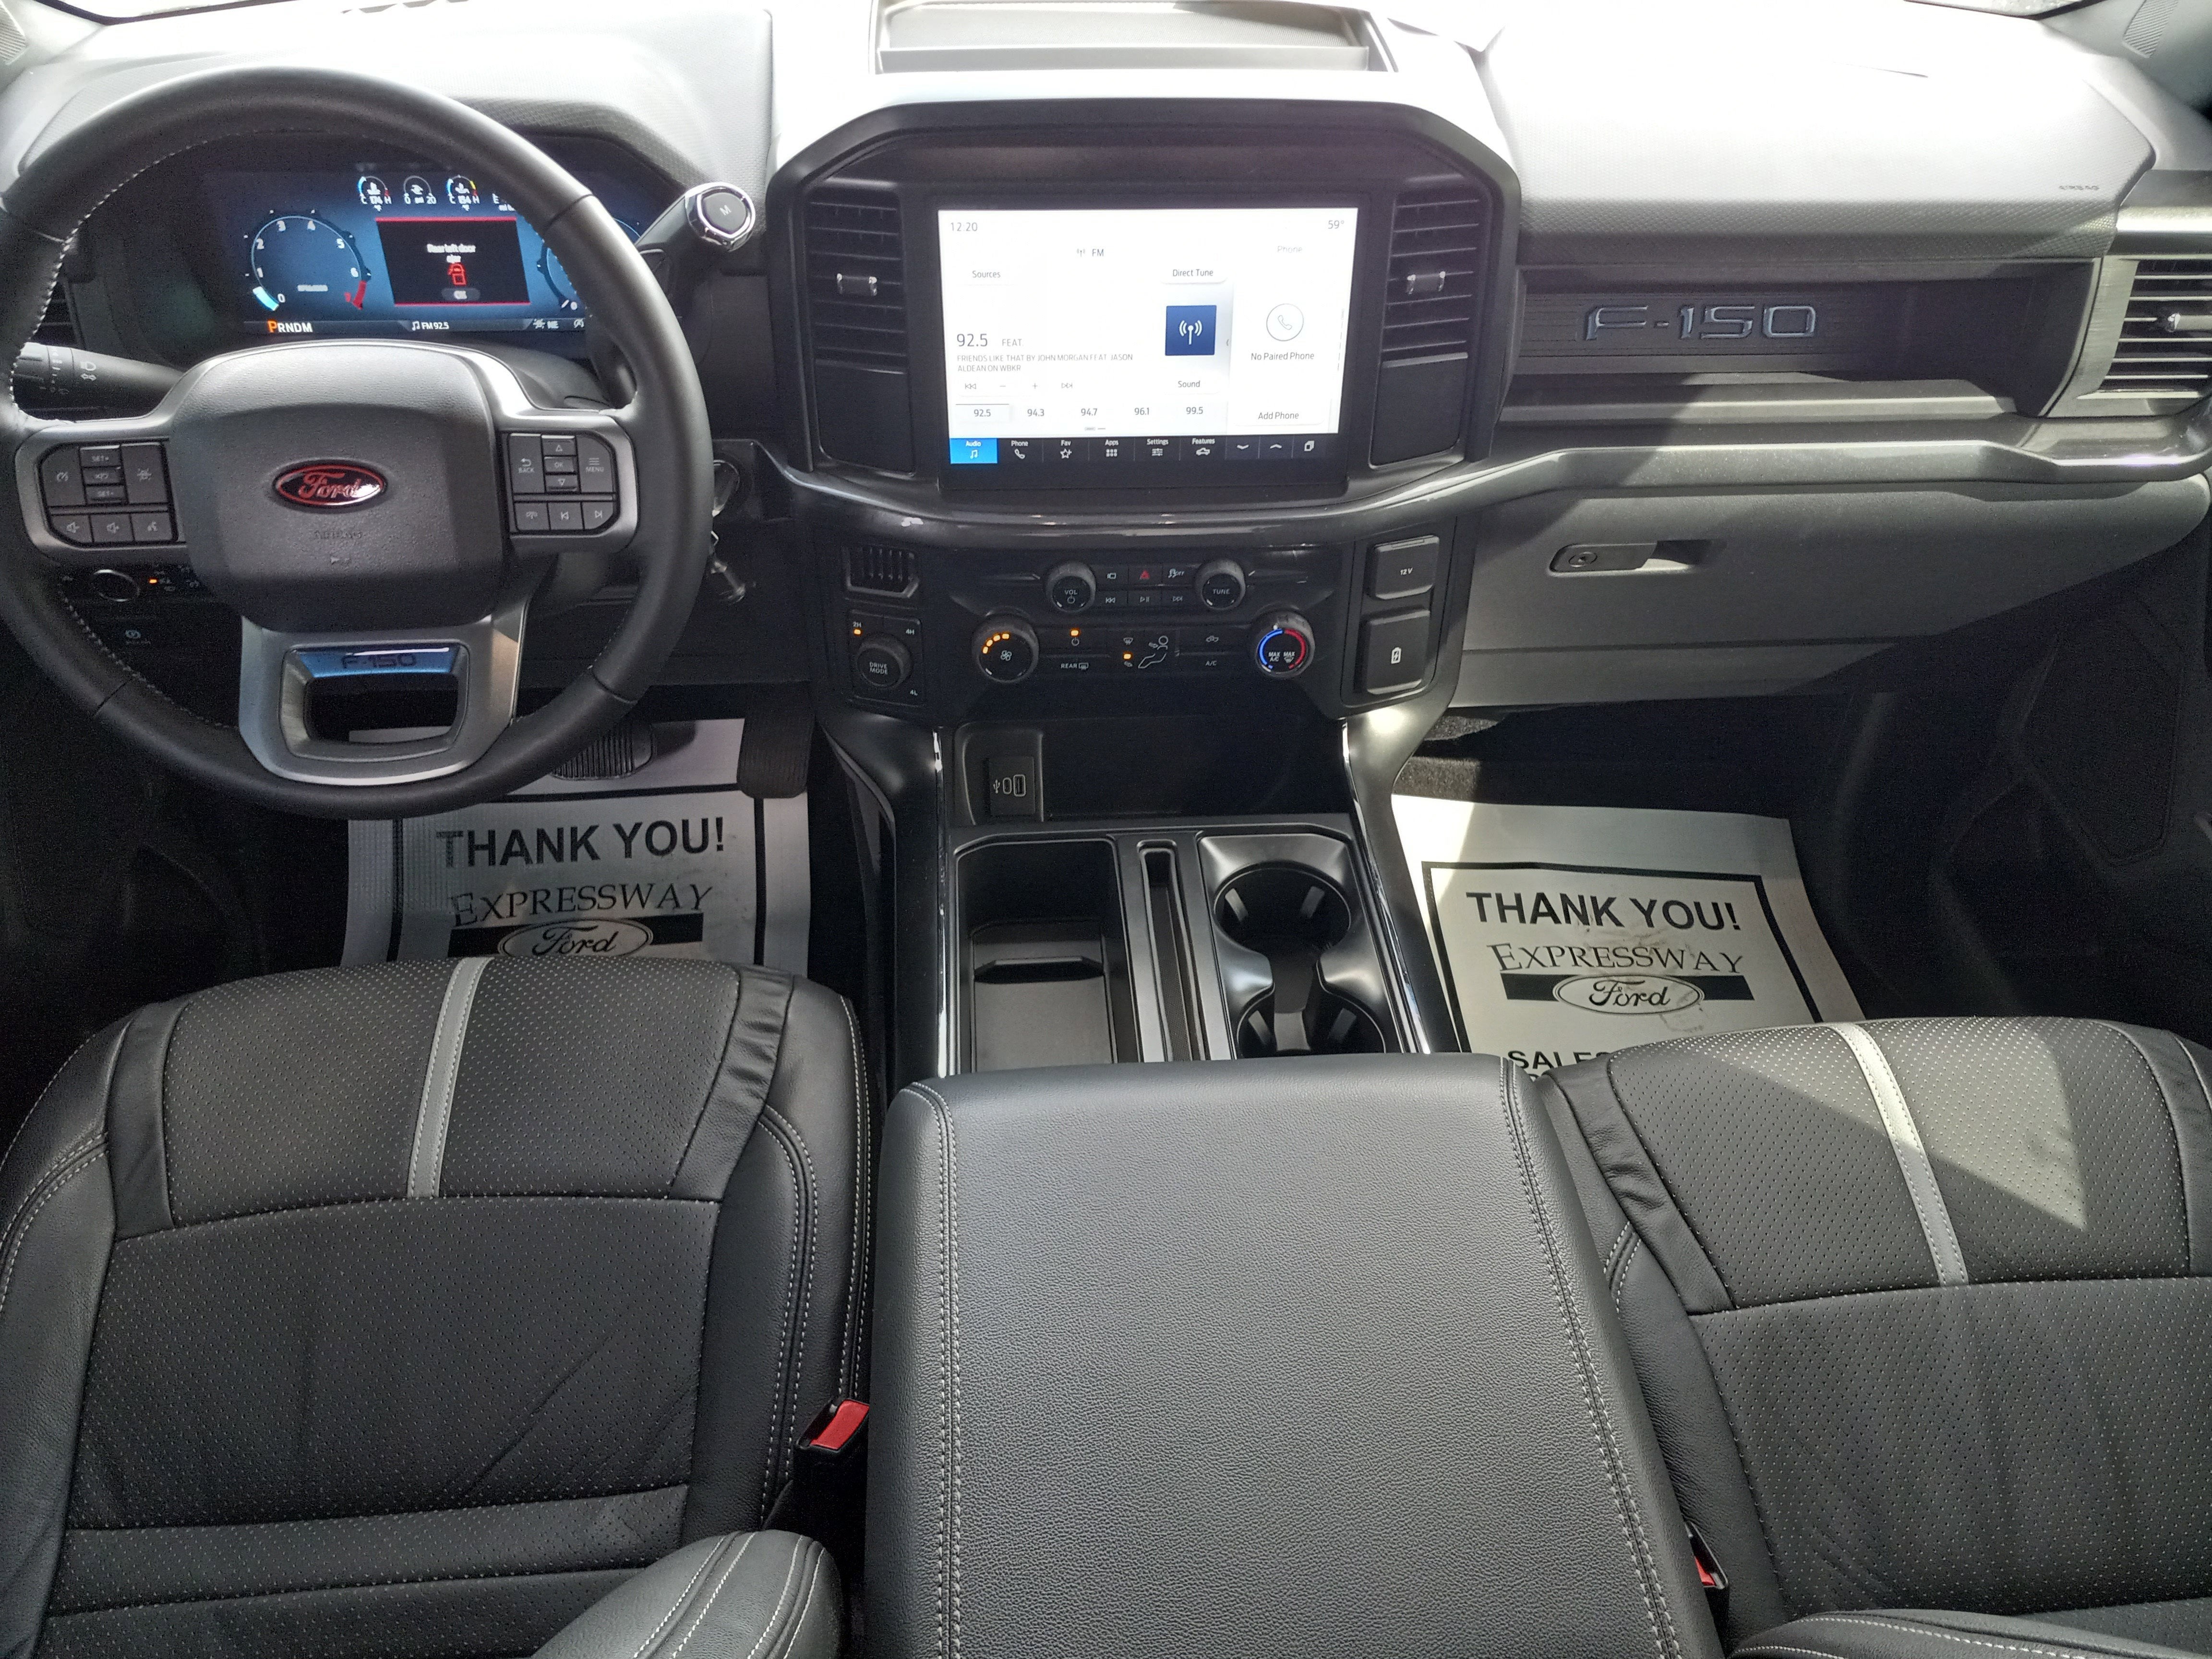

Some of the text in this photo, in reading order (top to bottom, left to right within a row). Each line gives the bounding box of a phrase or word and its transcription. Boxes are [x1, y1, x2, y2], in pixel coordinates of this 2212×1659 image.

[719, 204, 732, 216] M
[276, 220, 287, 231] 3
[307, 220, 316, 231] 4
[950, 222, 978, 232] 12:20
[1327, 220, 1345, 229] 59°
[256, 238, 264, 250] 2
[336, 238, 345, 249] 5
[1092, 249, 1104, 257] FM
[1277, 245, 1303, 254] Phone
[350, 267, 359, 277] 6
[972, 270, 1001, 278] Sources
[1172, 269, 1193, 277] Direct
[277, 293, 286, 303] 0
[421, 322, 449, 330] FM 92.5
[1585, 304, 1816, 341] F-150
[956, 333, 988, 348] 92.5
[1263, 352, 1288, 361] Paired
[1290, 352, 1314, 360] Phone
[973, 409, 991, 417] 92.5
[1027, 409, 1045, 417] 94.3
[1080, 408, 1098, 416] 94.7
[1134, 408, 1150, 416] 96.1
[1186, 407, 1203, 415] 99.5
[1258, 412, 1274, 420] Add
[1105, 439, 1119, 447] Apps
[298, 471, 362, 499] Ford
[1400, 567, 1414, 576] 12V
[436, 816, 724, 867] THANK YOU!
[450, 883, 713, 927] EXPRESSWAY
[1466, 891, 1742, 931] THANK YOU!
[531, 924, 620, 955] Ford
[1487, 942, 1743, 974] EXPRESSWAY
[1588, 979, 1671, 1008] Ford
[1508, 1050, 1611, 1070] SALE
